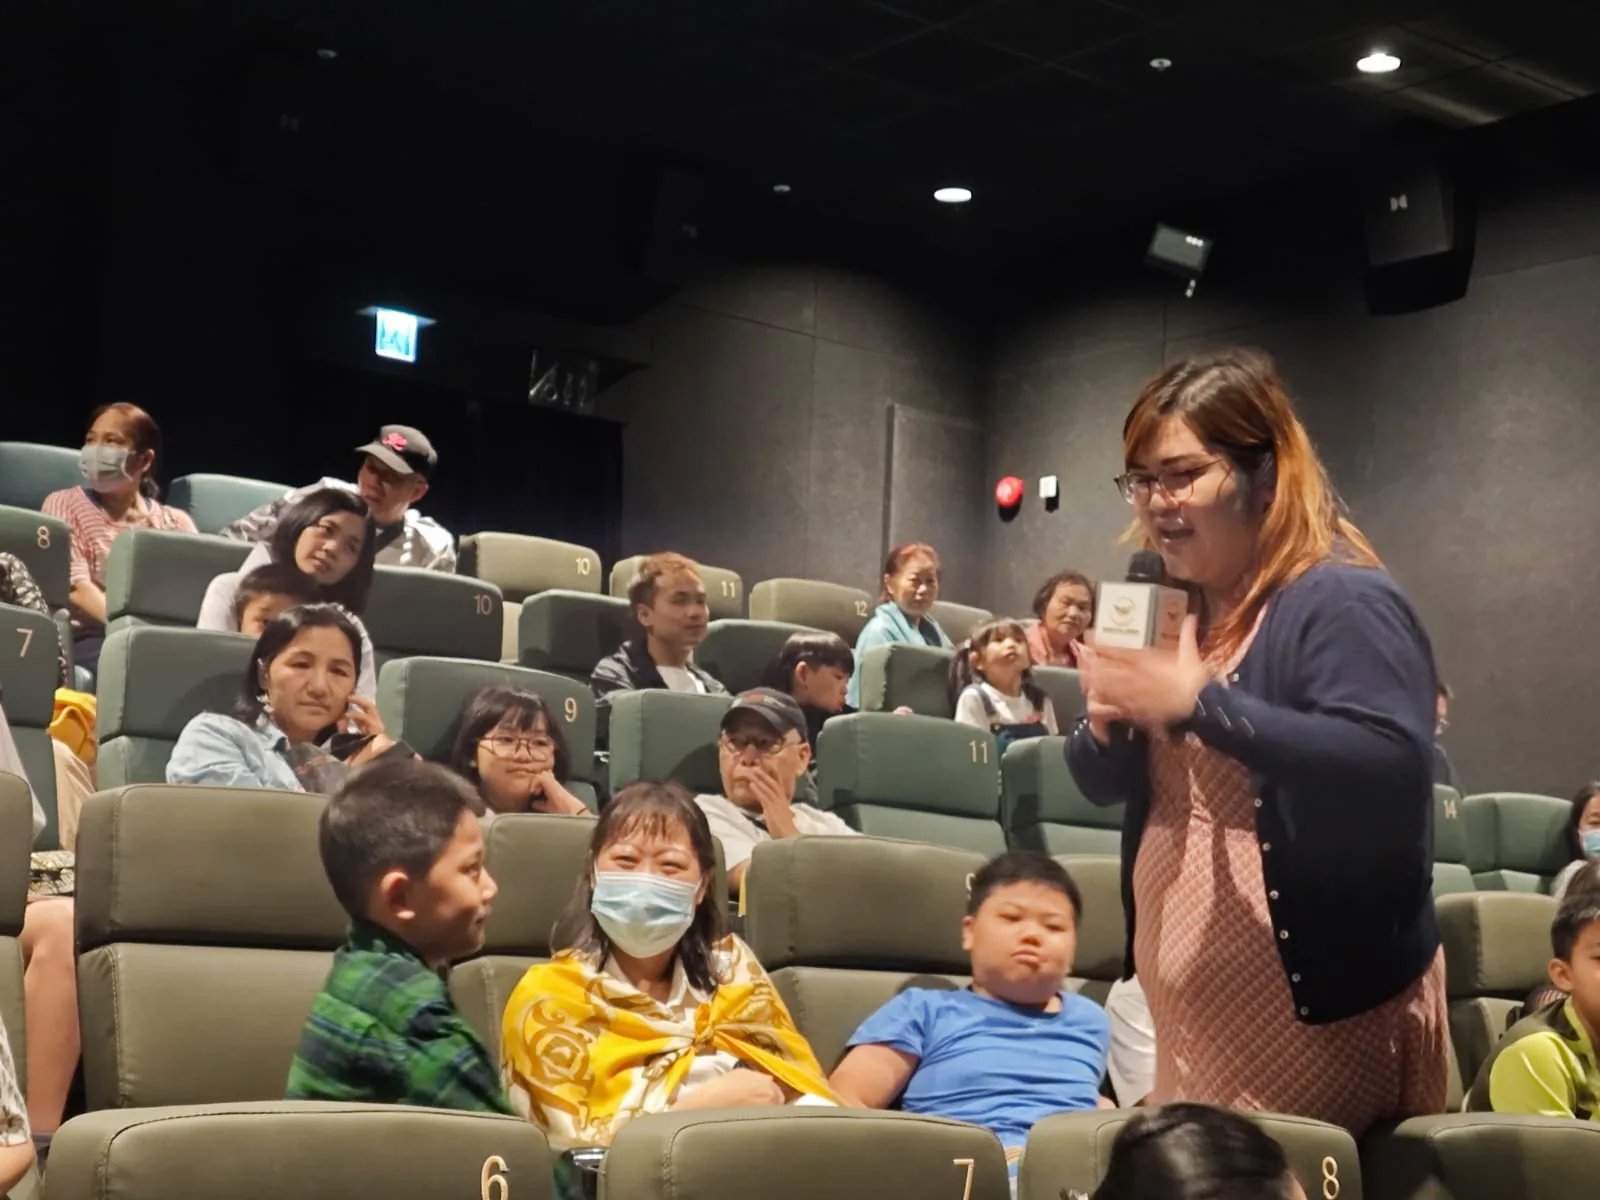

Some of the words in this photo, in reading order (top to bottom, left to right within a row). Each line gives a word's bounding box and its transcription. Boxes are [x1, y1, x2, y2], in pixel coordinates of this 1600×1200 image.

[37, 526, 51, 549] 8
[575, 557, 590, 575] 10
[721, 582, 735, 599] 11
[474, 594, 491, 616] 10
[854, 600, 868, 617] 12
[16, 628, 33, 657] 7
[564, 697, 578, 722] 9
[969, 741, 989, 764] 11
[480, 1156, 508, 1200] 6
[953, 1158, 975, 1200] 7
[1322, 1157, 1340, 1200] 8
